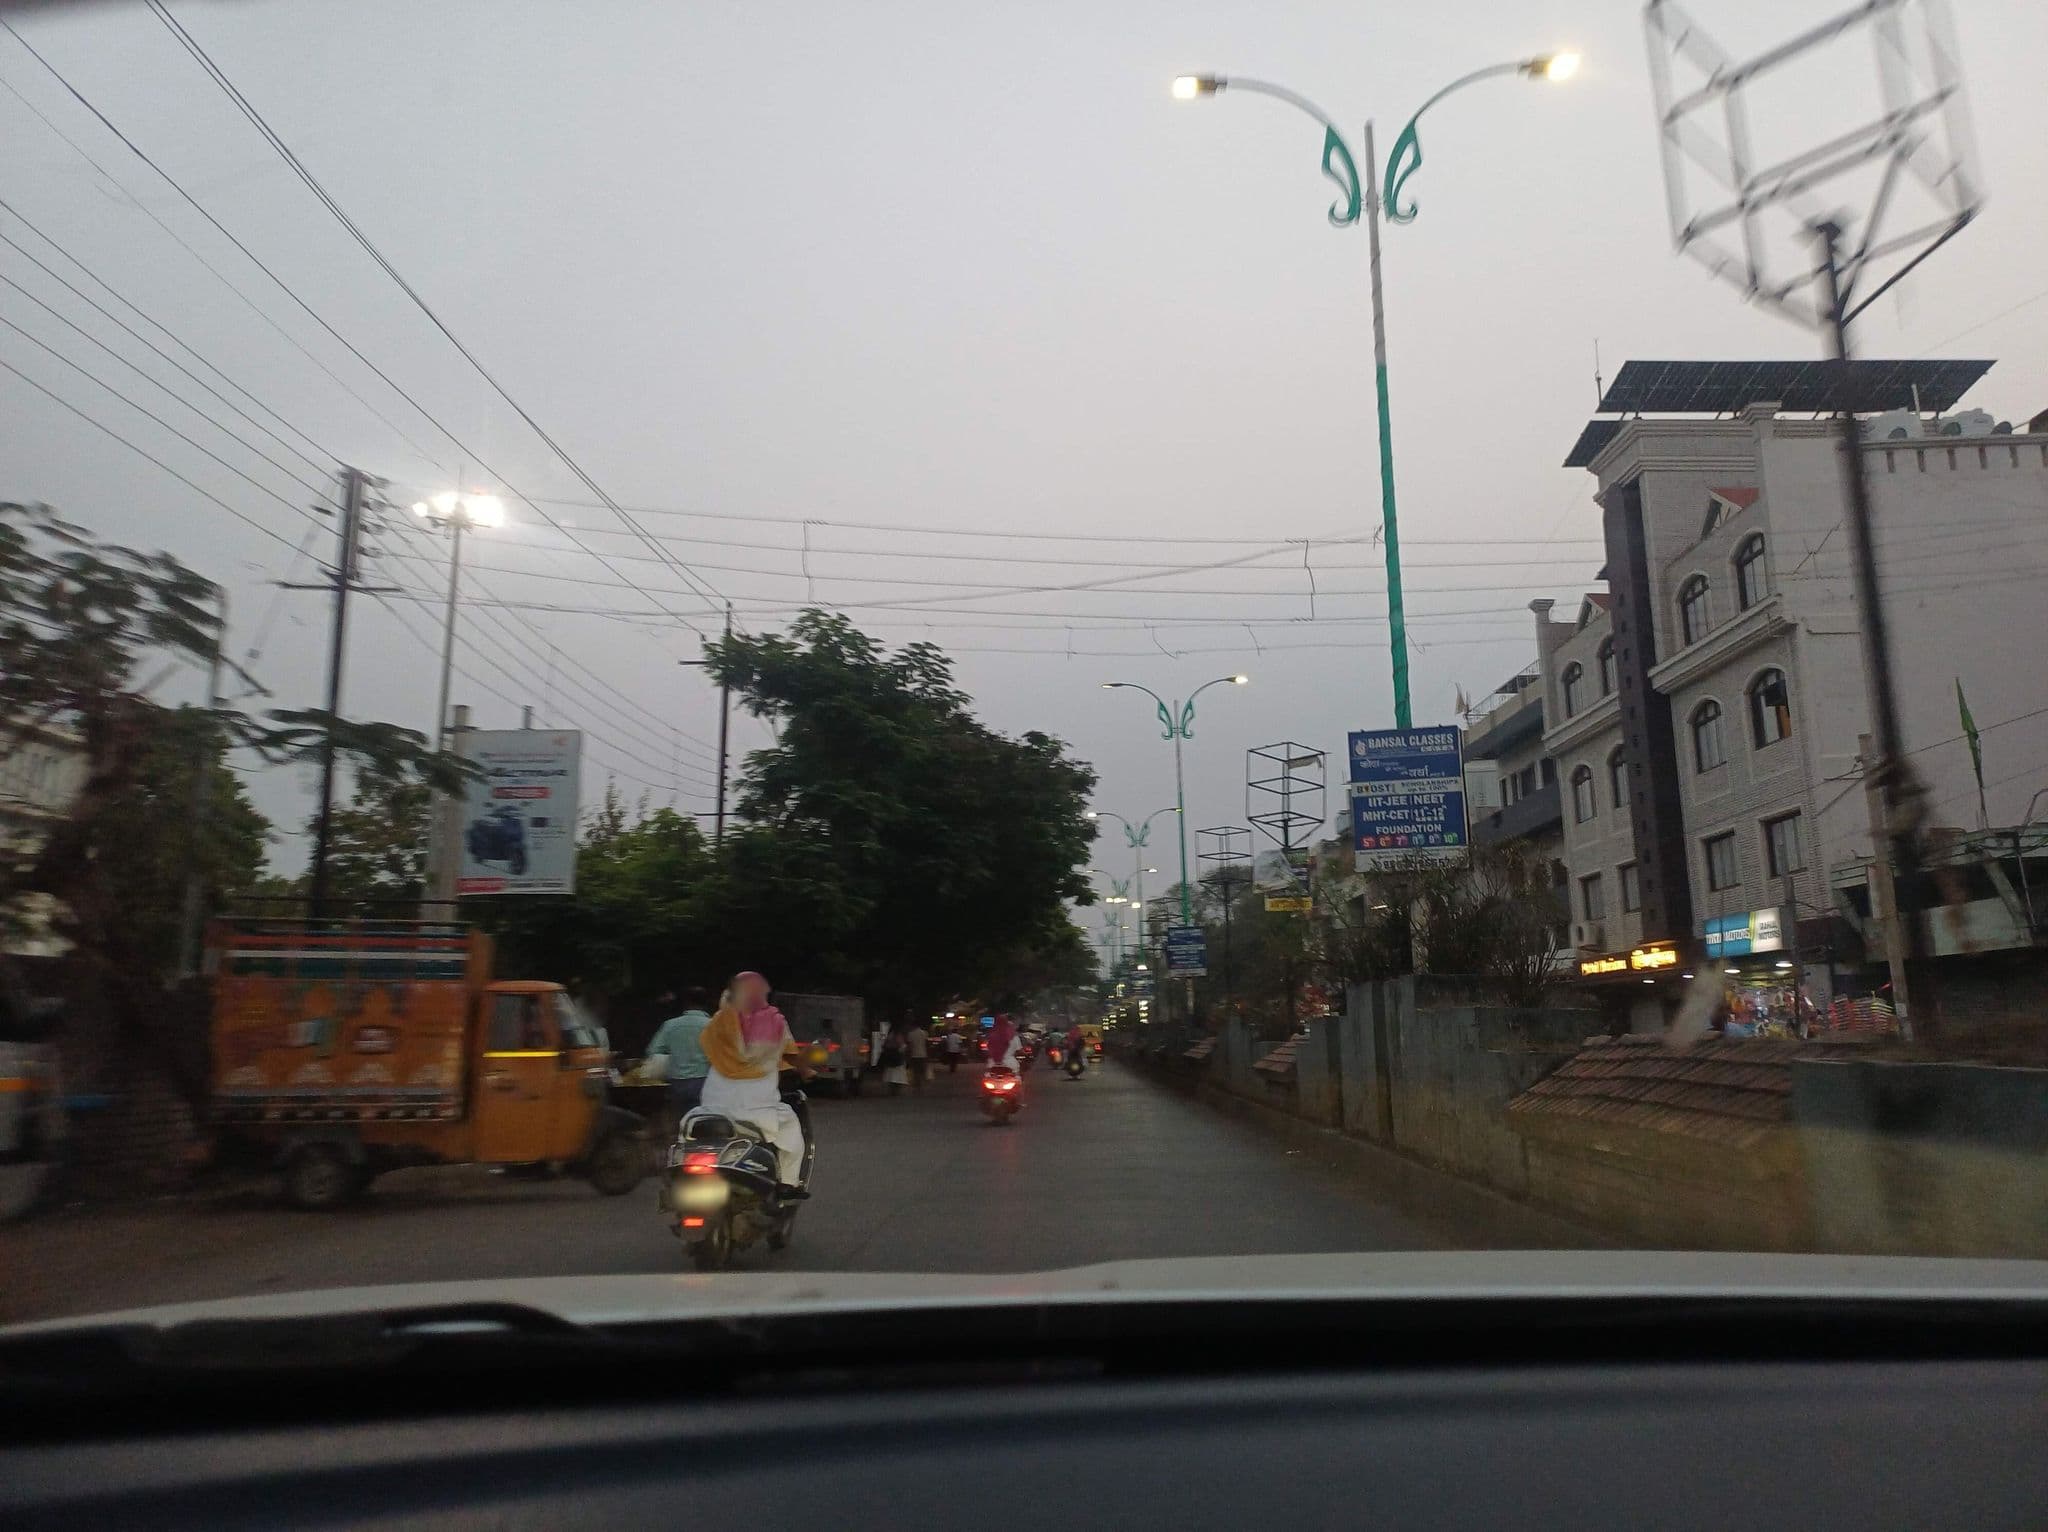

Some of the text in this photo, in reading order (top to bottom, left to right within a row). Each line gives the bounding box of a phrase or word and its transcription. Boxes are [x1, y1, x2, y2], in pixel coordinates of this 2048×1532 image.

[1368, 736, 1407, 749] BANSAL
[1409, 733, 1454, 747] CLASSES
[1368, 793, 1445, 807] IIT-JEE NEET
[1362, 809, 1410, 822] MHT-CET
[1375, 823, 1442, 835] FOUNDATION
